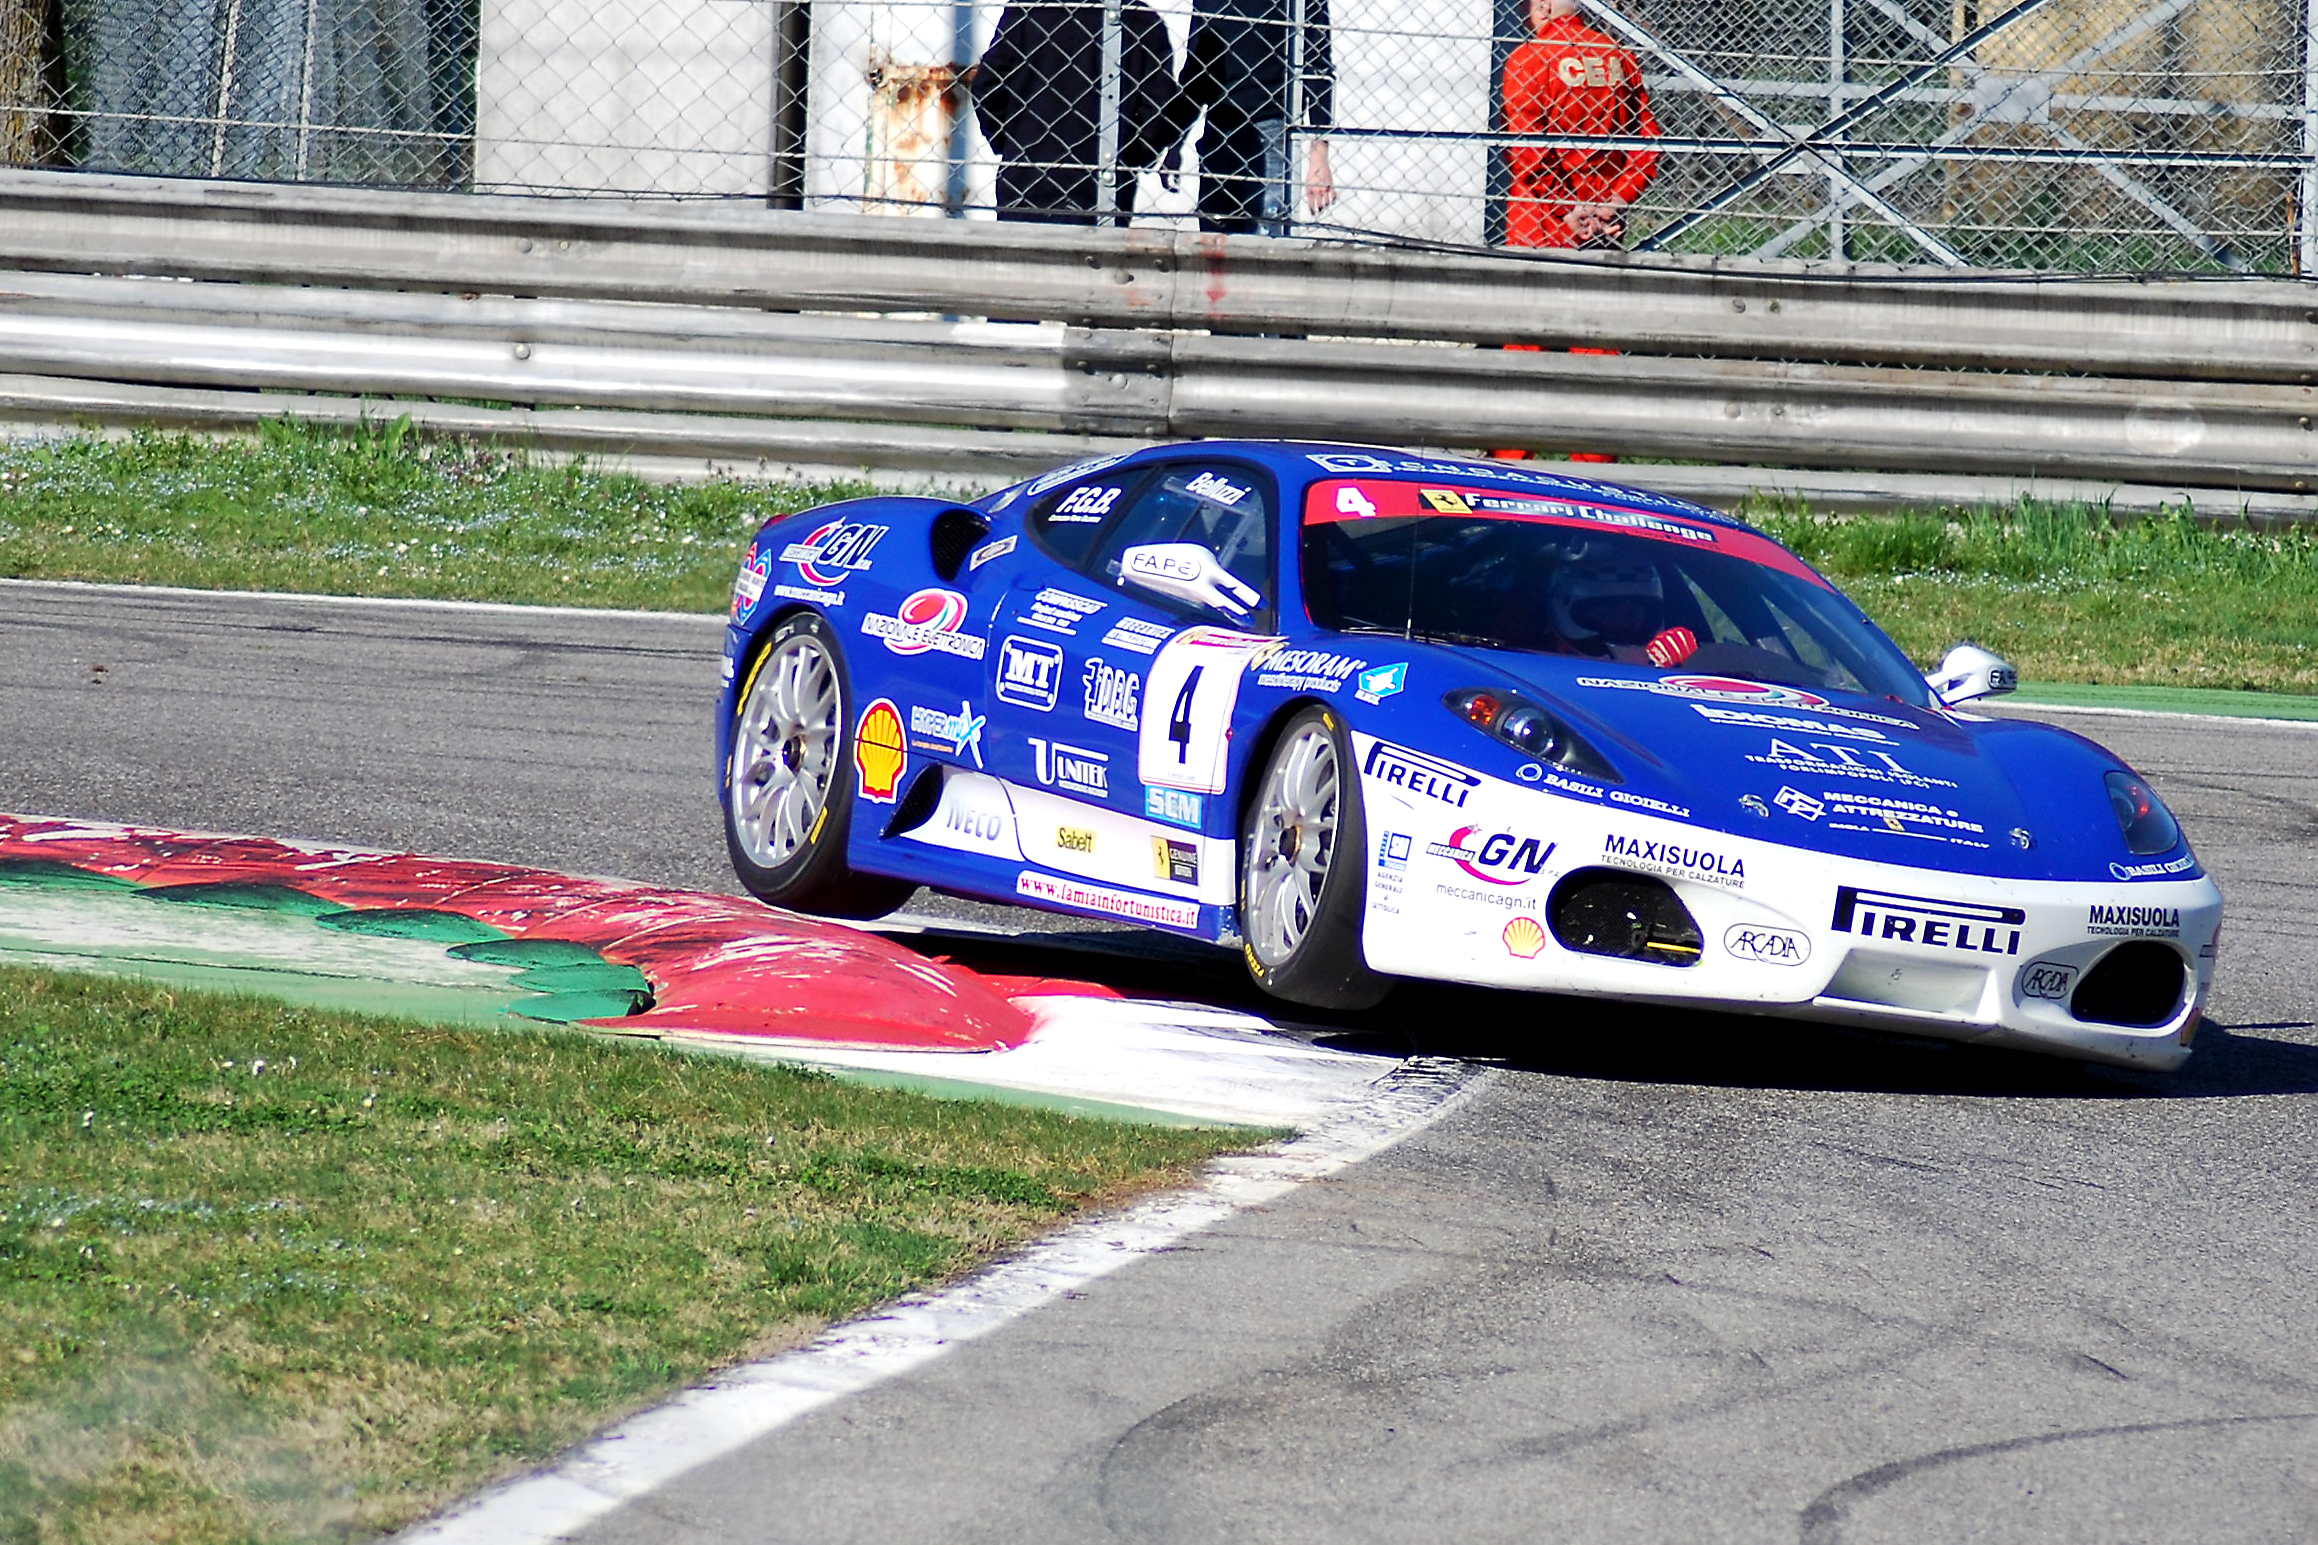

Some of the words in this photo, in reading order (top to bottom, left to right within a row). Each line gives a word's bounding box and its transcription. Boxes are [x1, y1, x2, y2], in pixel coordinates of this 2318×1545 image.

[1559, 57, 1624, 87] CEA
[1186, 472, 1251, 506] Belluzzi
[1336, 487, 1377, 517] 4
[1464, 492, 1574, 517] Ferrari
[1579, 505, 1713, 541] Challenge
[866, 616, 920, 642] NAZIONALE
[921, 629, 983, 657] ELETTRONICA
[1005, 648, 1054, 689] MT
[1169, 665, 1204, 764] 4
[1363, 740, 1481, 808] PIRELLI
[1768, 738, 1912, 774] ATI
[1148, 787, 1199, 824] SEM
[1543, 773, 1604, 798] BASILI
[1609, 791, 1690, 818] GIOIELLI
[1823, 791, 1942, 815] MECCANICA
[946, 798, 1002, 841] IVECO
[1832, 804, 1985, 833] ATTREZZATURE
[1057, 827, 1092, 853] Sabelt
[1478, 832, 1556, 874] GN
[1604, 834, 1746, 878] MAXISUOLA
[1950, 836, 1990, 849] ITALY
[1601, 854, 1663, 875] TECNOLOGIA
[1665, 866, 1686, 878] PER
[1688, 871, 1746, 889] CALZATURE
[1020, 877, 1196, 926] www.lamiainfortunistica.it
[1436, 884, 1536, 910] meccanicagn.it
[1831, 885, 2026, 955] PIRELLI
[2087, 925, 2129, 936] TECNOLOGIA
[2131, 928, 2144, 937] PER
[2145, 928, 2180, 938] CALZATURE
[2089, 904, 2180, 928] MAXISUOLA
